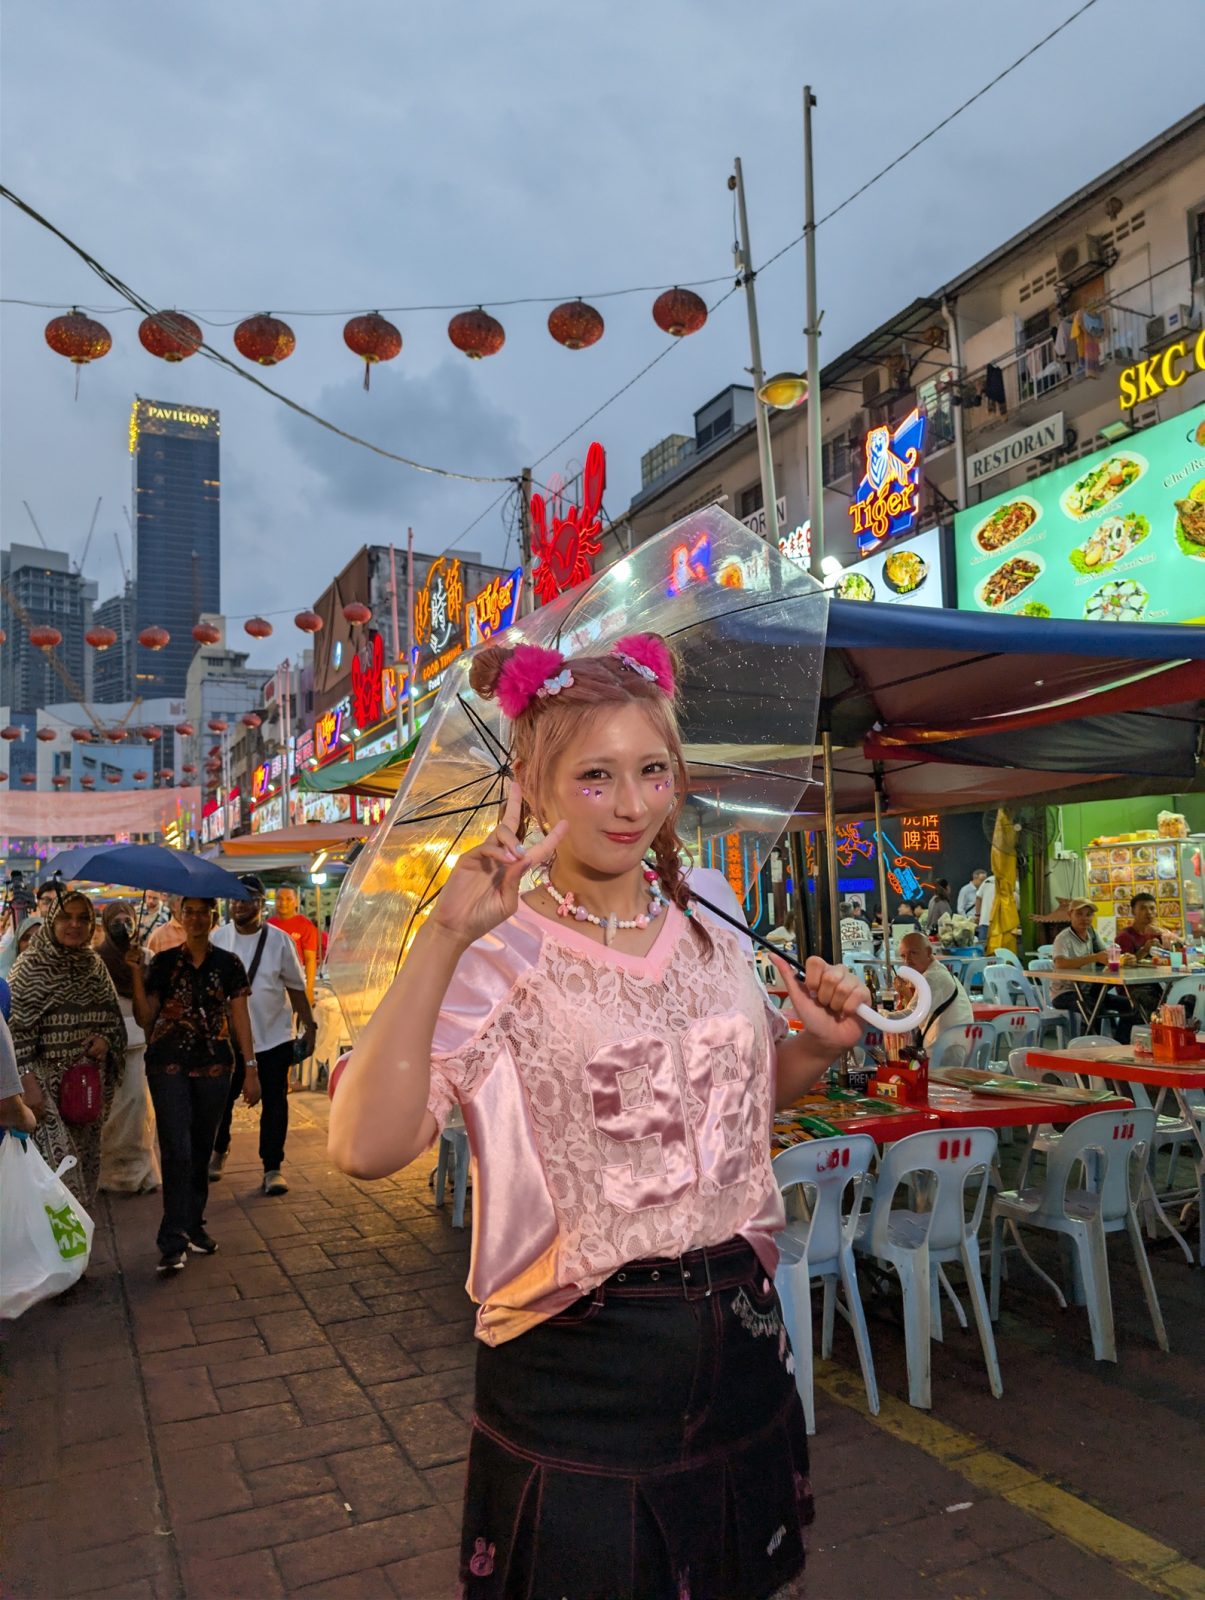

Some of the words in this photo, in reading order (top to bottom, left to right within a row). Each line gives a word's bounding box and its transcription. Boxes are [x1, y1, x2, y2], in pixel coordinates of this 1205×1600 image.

[1119, 341, 1186, 411] SKC
[148, 406, 209, 425] PAVILION
[973, 423, 1056, 478] RESTORAN
[849, 483, 915, 538] Tiger
[477, 577, 514, 630] Tiger
[903, 830, 940, 851] 啤酒
